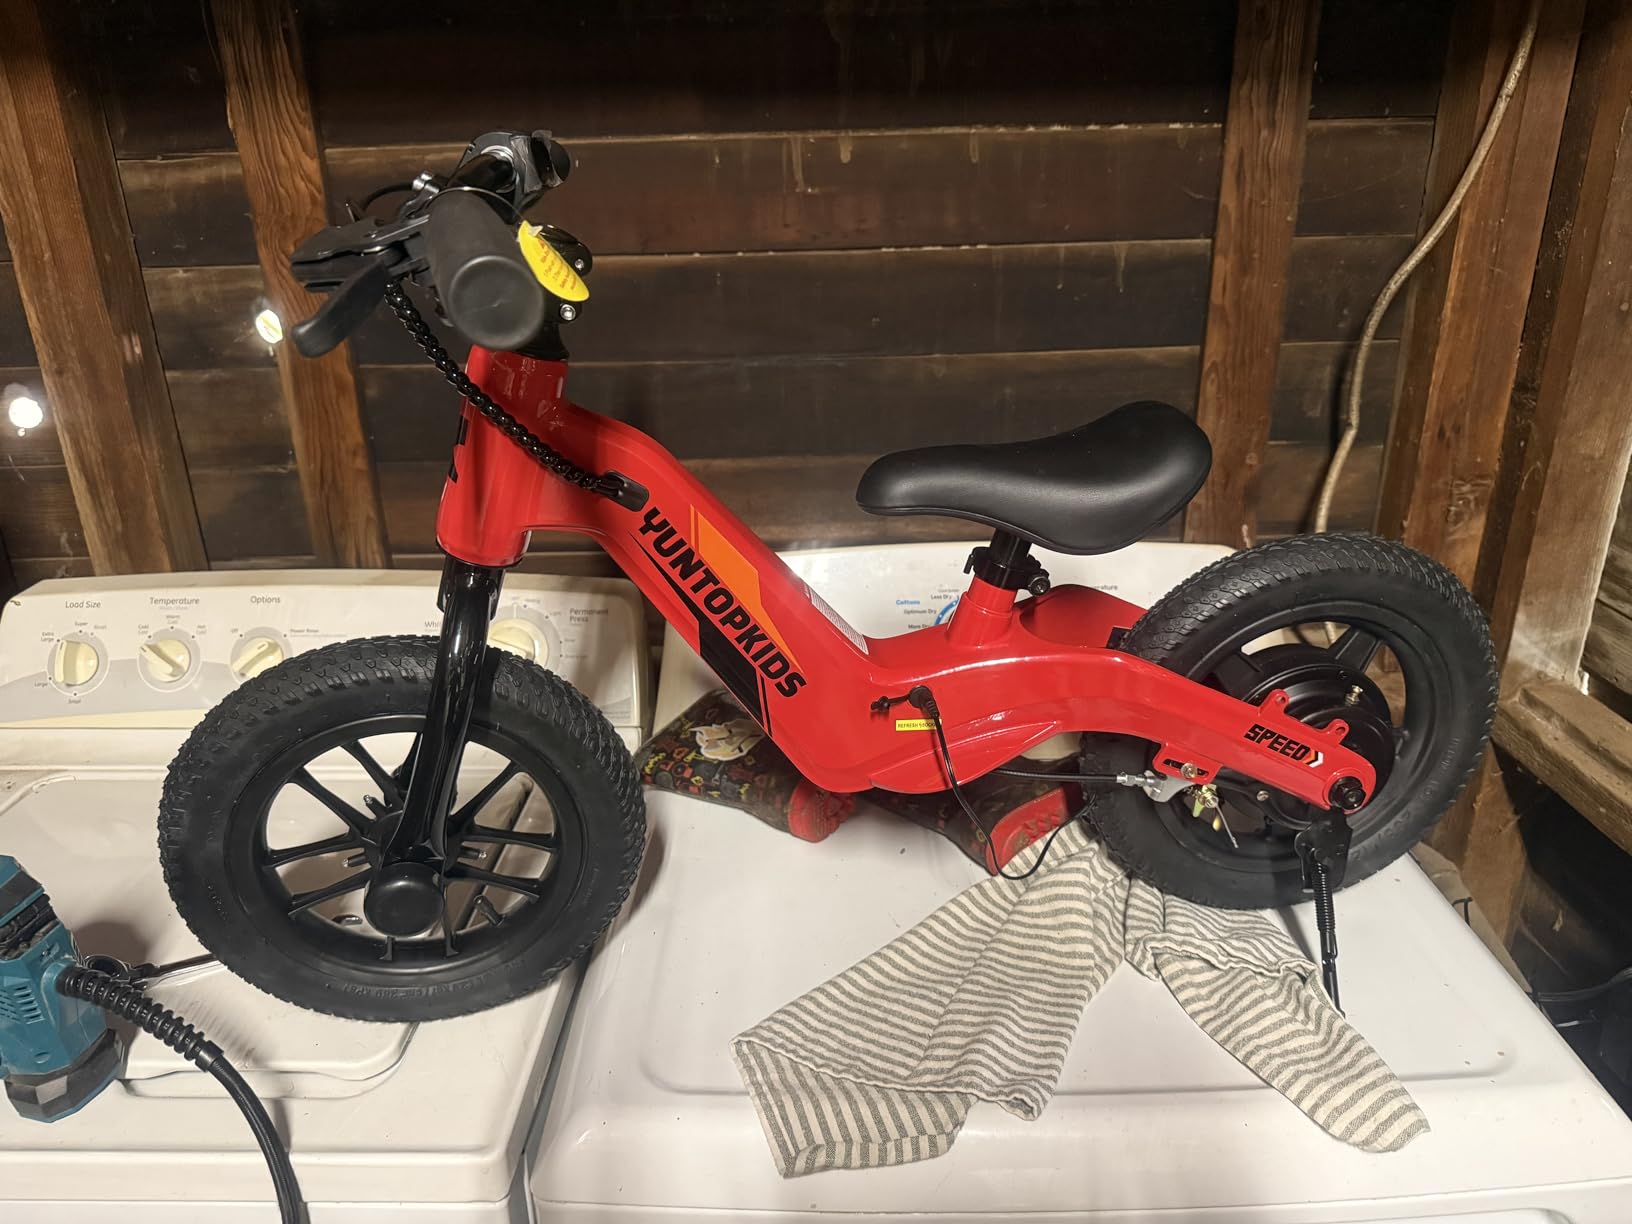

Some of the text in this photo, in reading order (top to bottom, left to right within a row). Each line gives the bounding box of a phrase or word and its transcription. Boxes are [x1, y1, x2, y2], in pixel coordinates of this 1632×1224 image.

[65, 600, 102, 609] Load Size
[149, 596, 200, 606] Temperature
[250, 595, 281, 605] Options
[638, 506, 807, 698] YUNTOPKIDS
[569, 607, 609, 615] Permanent
[569, 615, 589, 623] Press
[1243, 723, 1311, 761] SPEED
